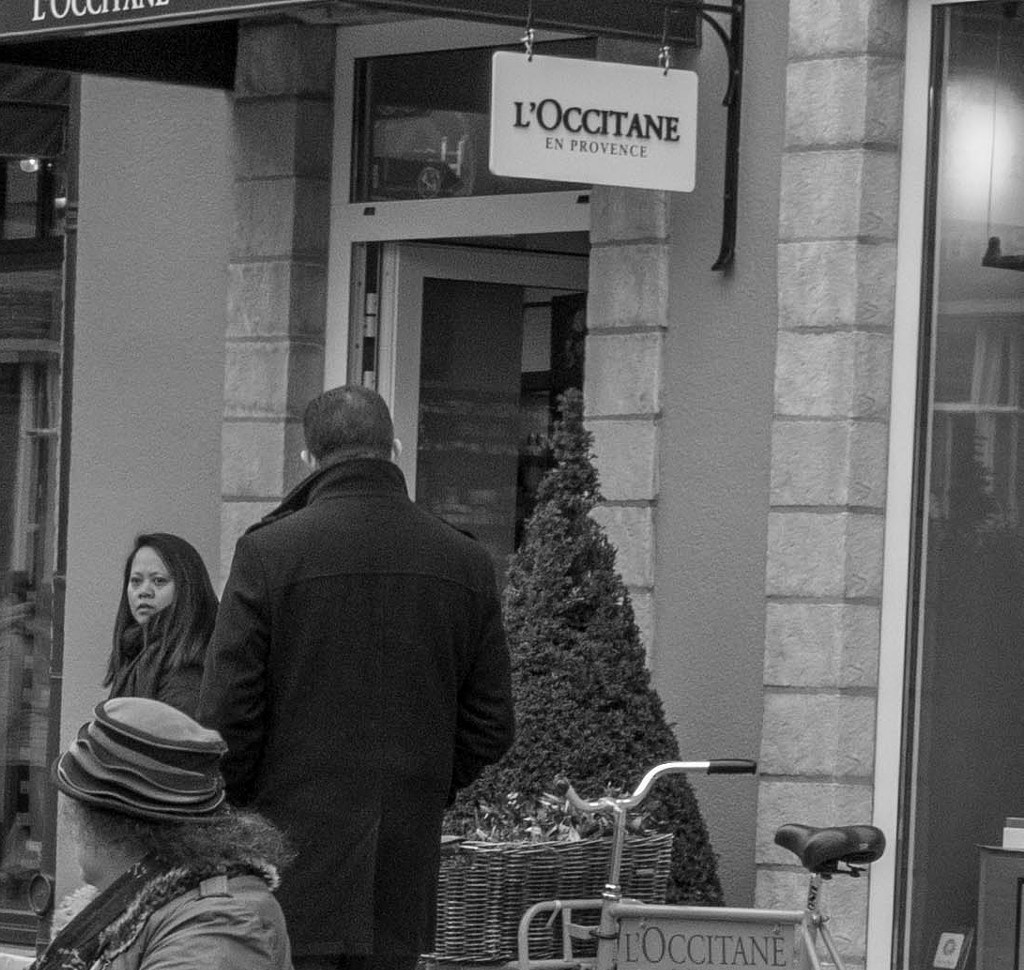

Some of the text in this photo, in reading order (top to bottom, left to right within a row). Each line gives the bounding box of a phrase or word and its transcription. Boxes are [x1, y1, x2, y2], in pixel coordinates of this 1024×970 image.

[32, 0, 170, 21] LOCCI
[513, 98, 681, 142] L'OCCITANE
[545, 137, 648, 158] EN PROVENCE
[625, 926, 787, 967] L'OCCITANE
